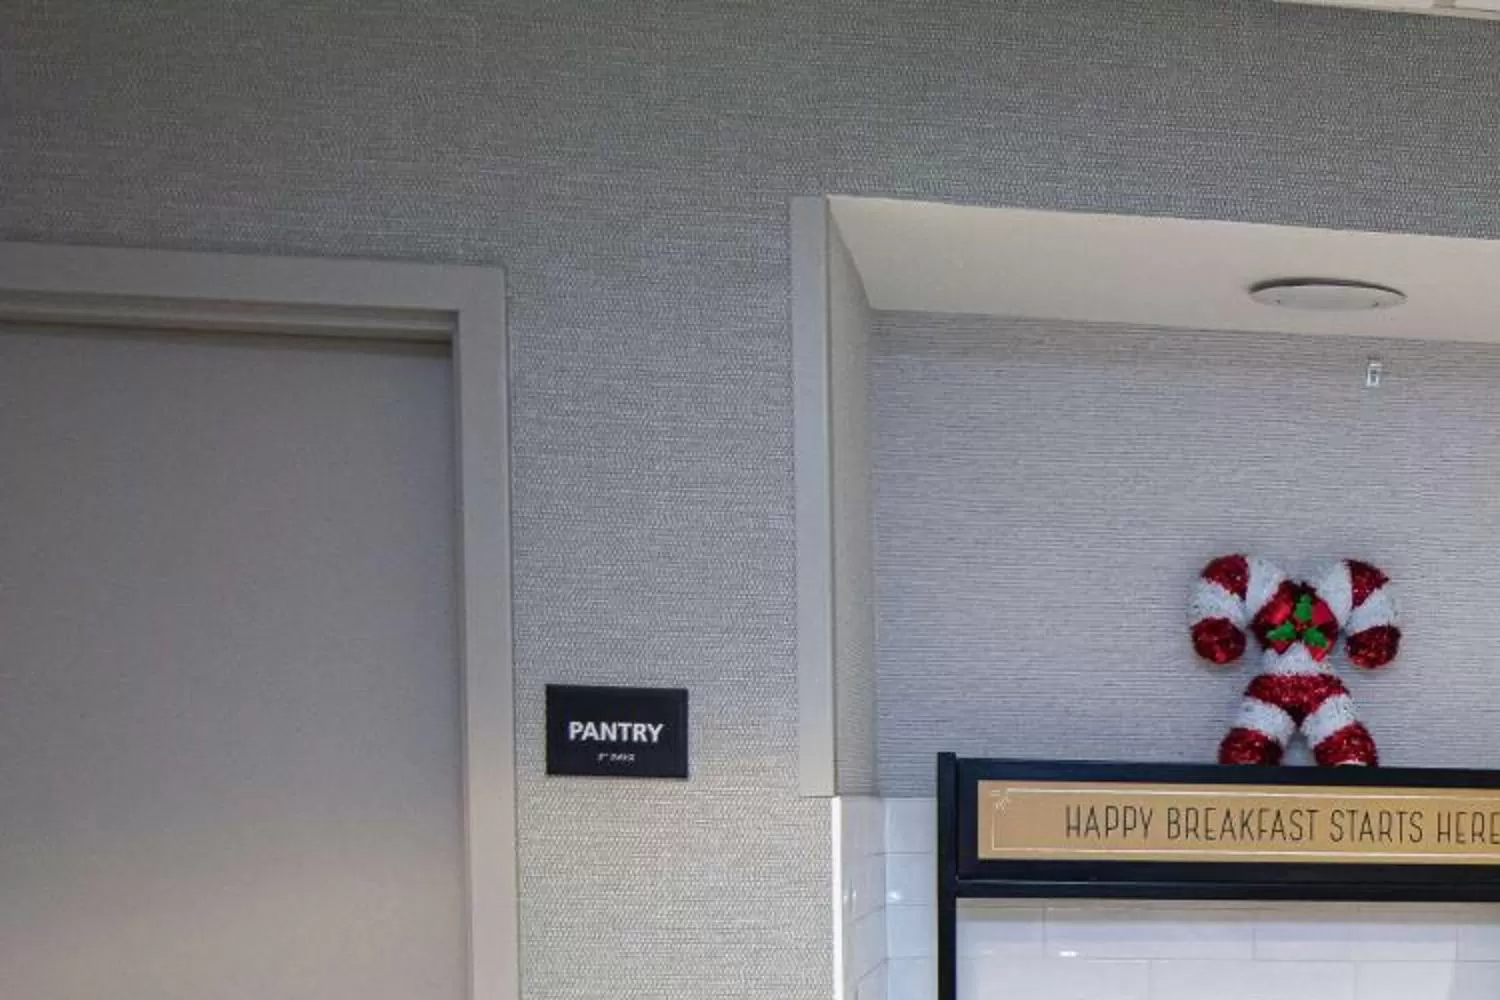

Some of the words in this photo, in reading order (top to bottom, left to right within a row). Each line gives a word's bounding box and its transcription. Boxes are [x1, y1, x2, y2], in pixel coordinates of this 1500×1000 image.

[568, 721, 664, 743] PANTRY
[1065, 804, 1153, 840] HAPPY
[1166, 806, 1320, 843] BREAKFAST
[1329, 808, 1424, 845] STARTS
